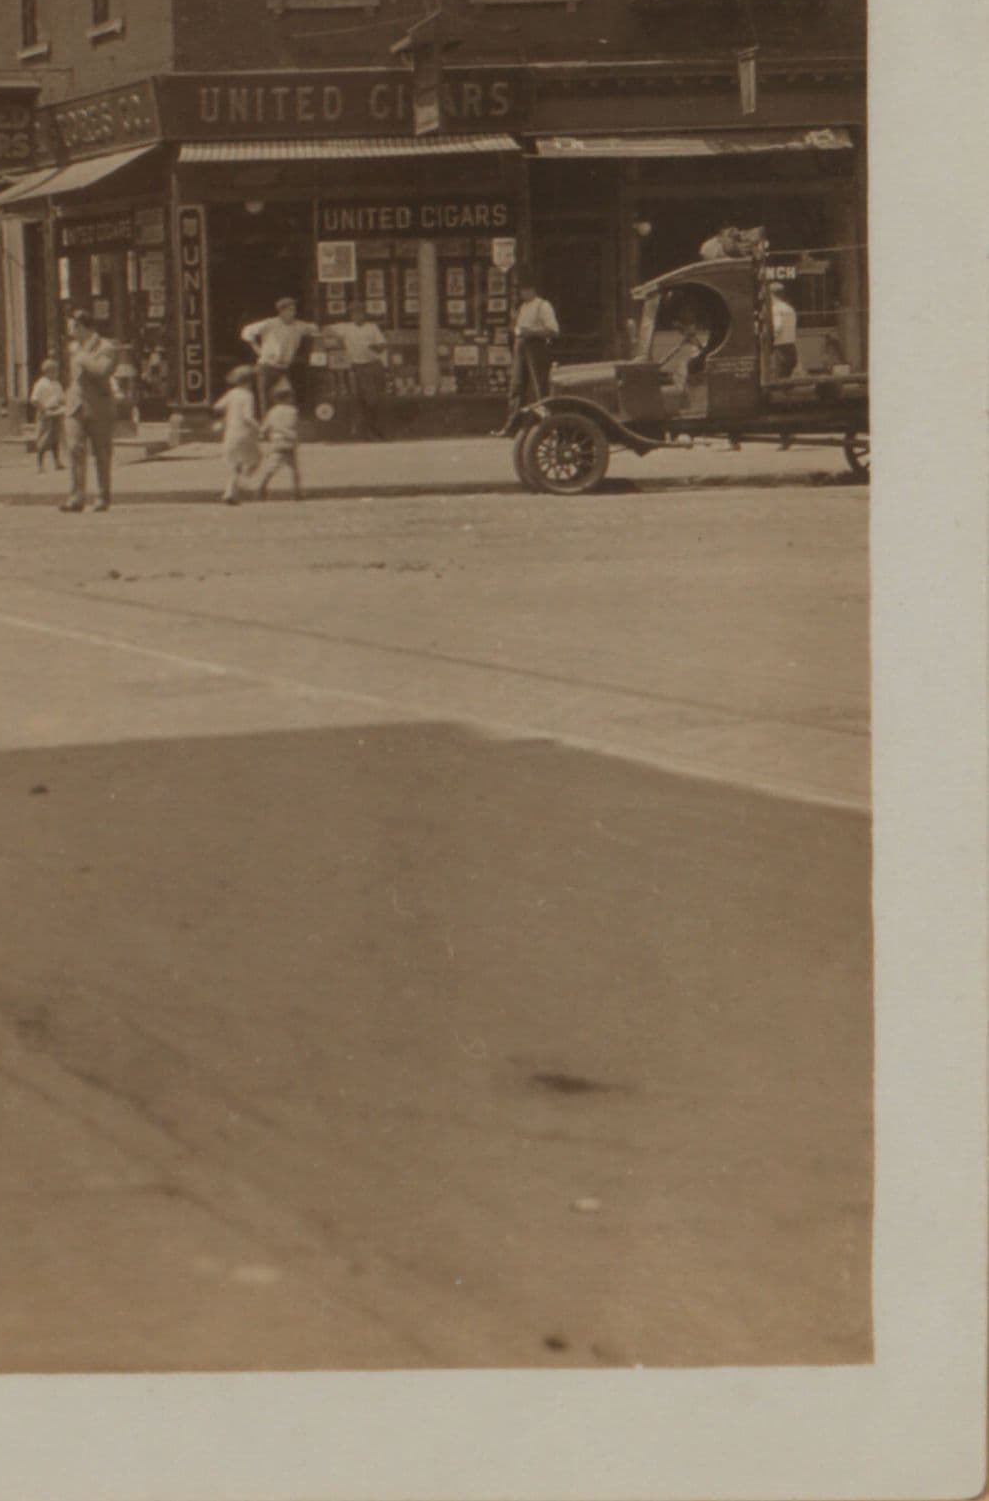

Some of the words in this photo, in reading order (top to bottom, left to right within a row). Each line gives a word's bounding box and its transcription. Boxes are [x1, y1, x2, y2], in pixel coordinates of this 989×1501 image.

[199, 85, 343, 123] UNITED
[368, 81, 511, 121] CIARS
[323, 207, 411, 231] UNITED
[420, 203, 508, 228] CIGARS
[764, 265, 797, 280] NCH
[183, 245, 203, 390] UNITED
